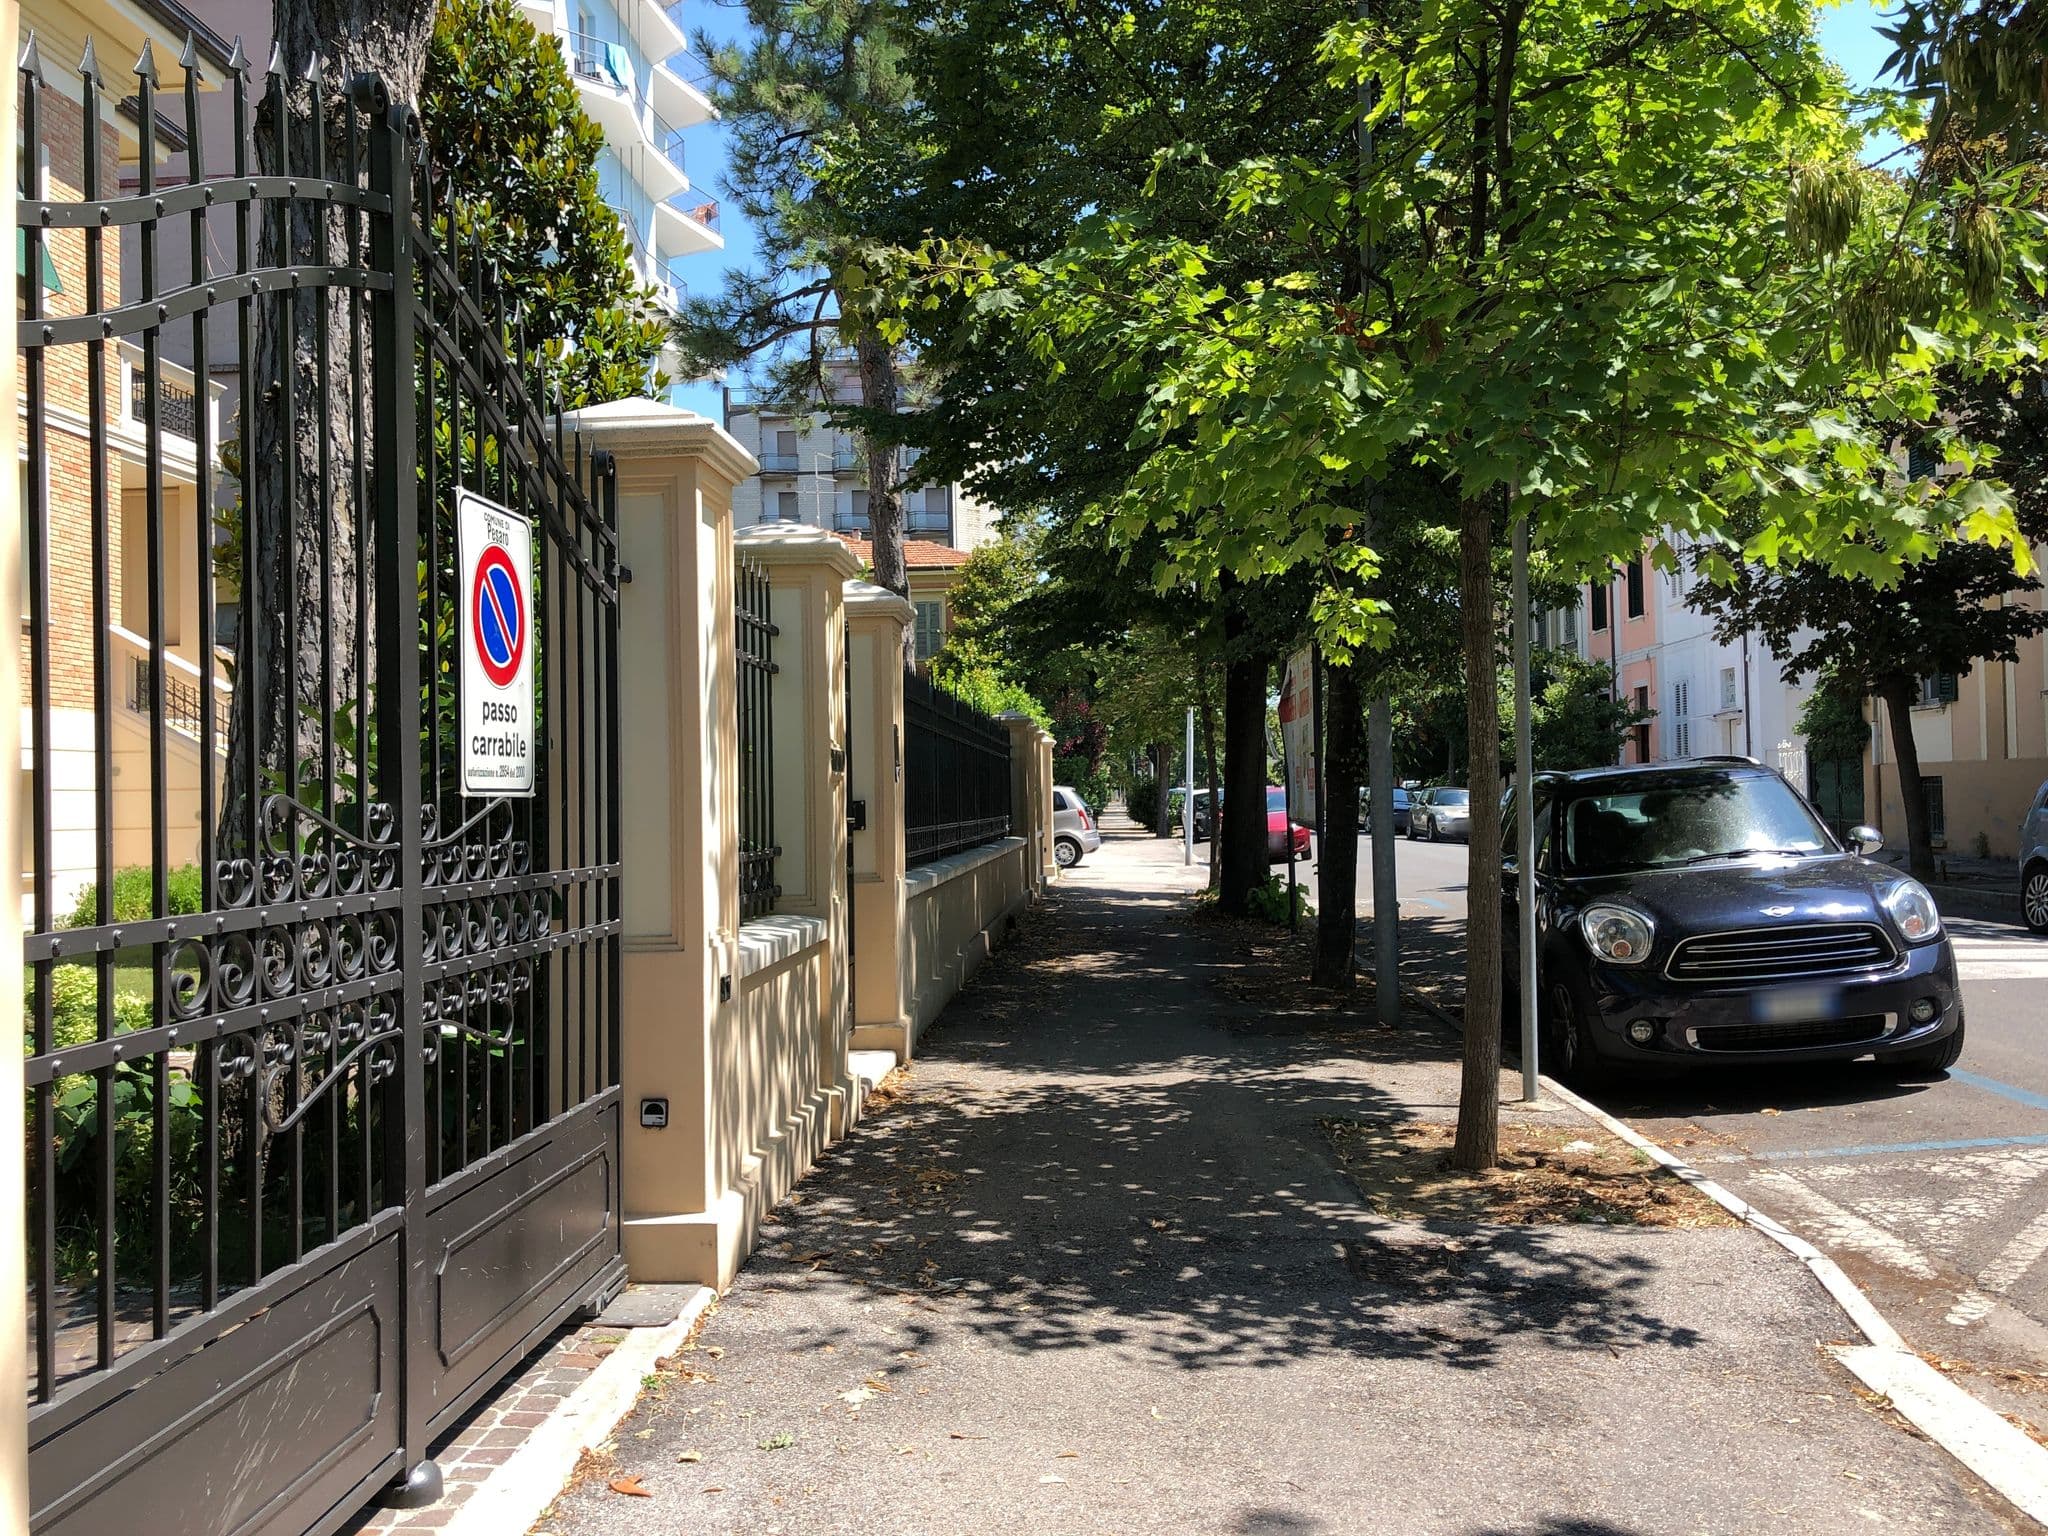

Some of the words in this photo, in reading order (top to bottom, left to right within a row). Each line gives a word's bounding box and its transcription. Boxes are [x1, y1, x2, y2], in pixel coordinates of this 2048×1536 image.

[484, 512, 504, 528] COMUNE
[487, 523, 509, 546] Pesaro
[482, 701, 518, 725] passo
[472, 731, 526, 758] carrabile
